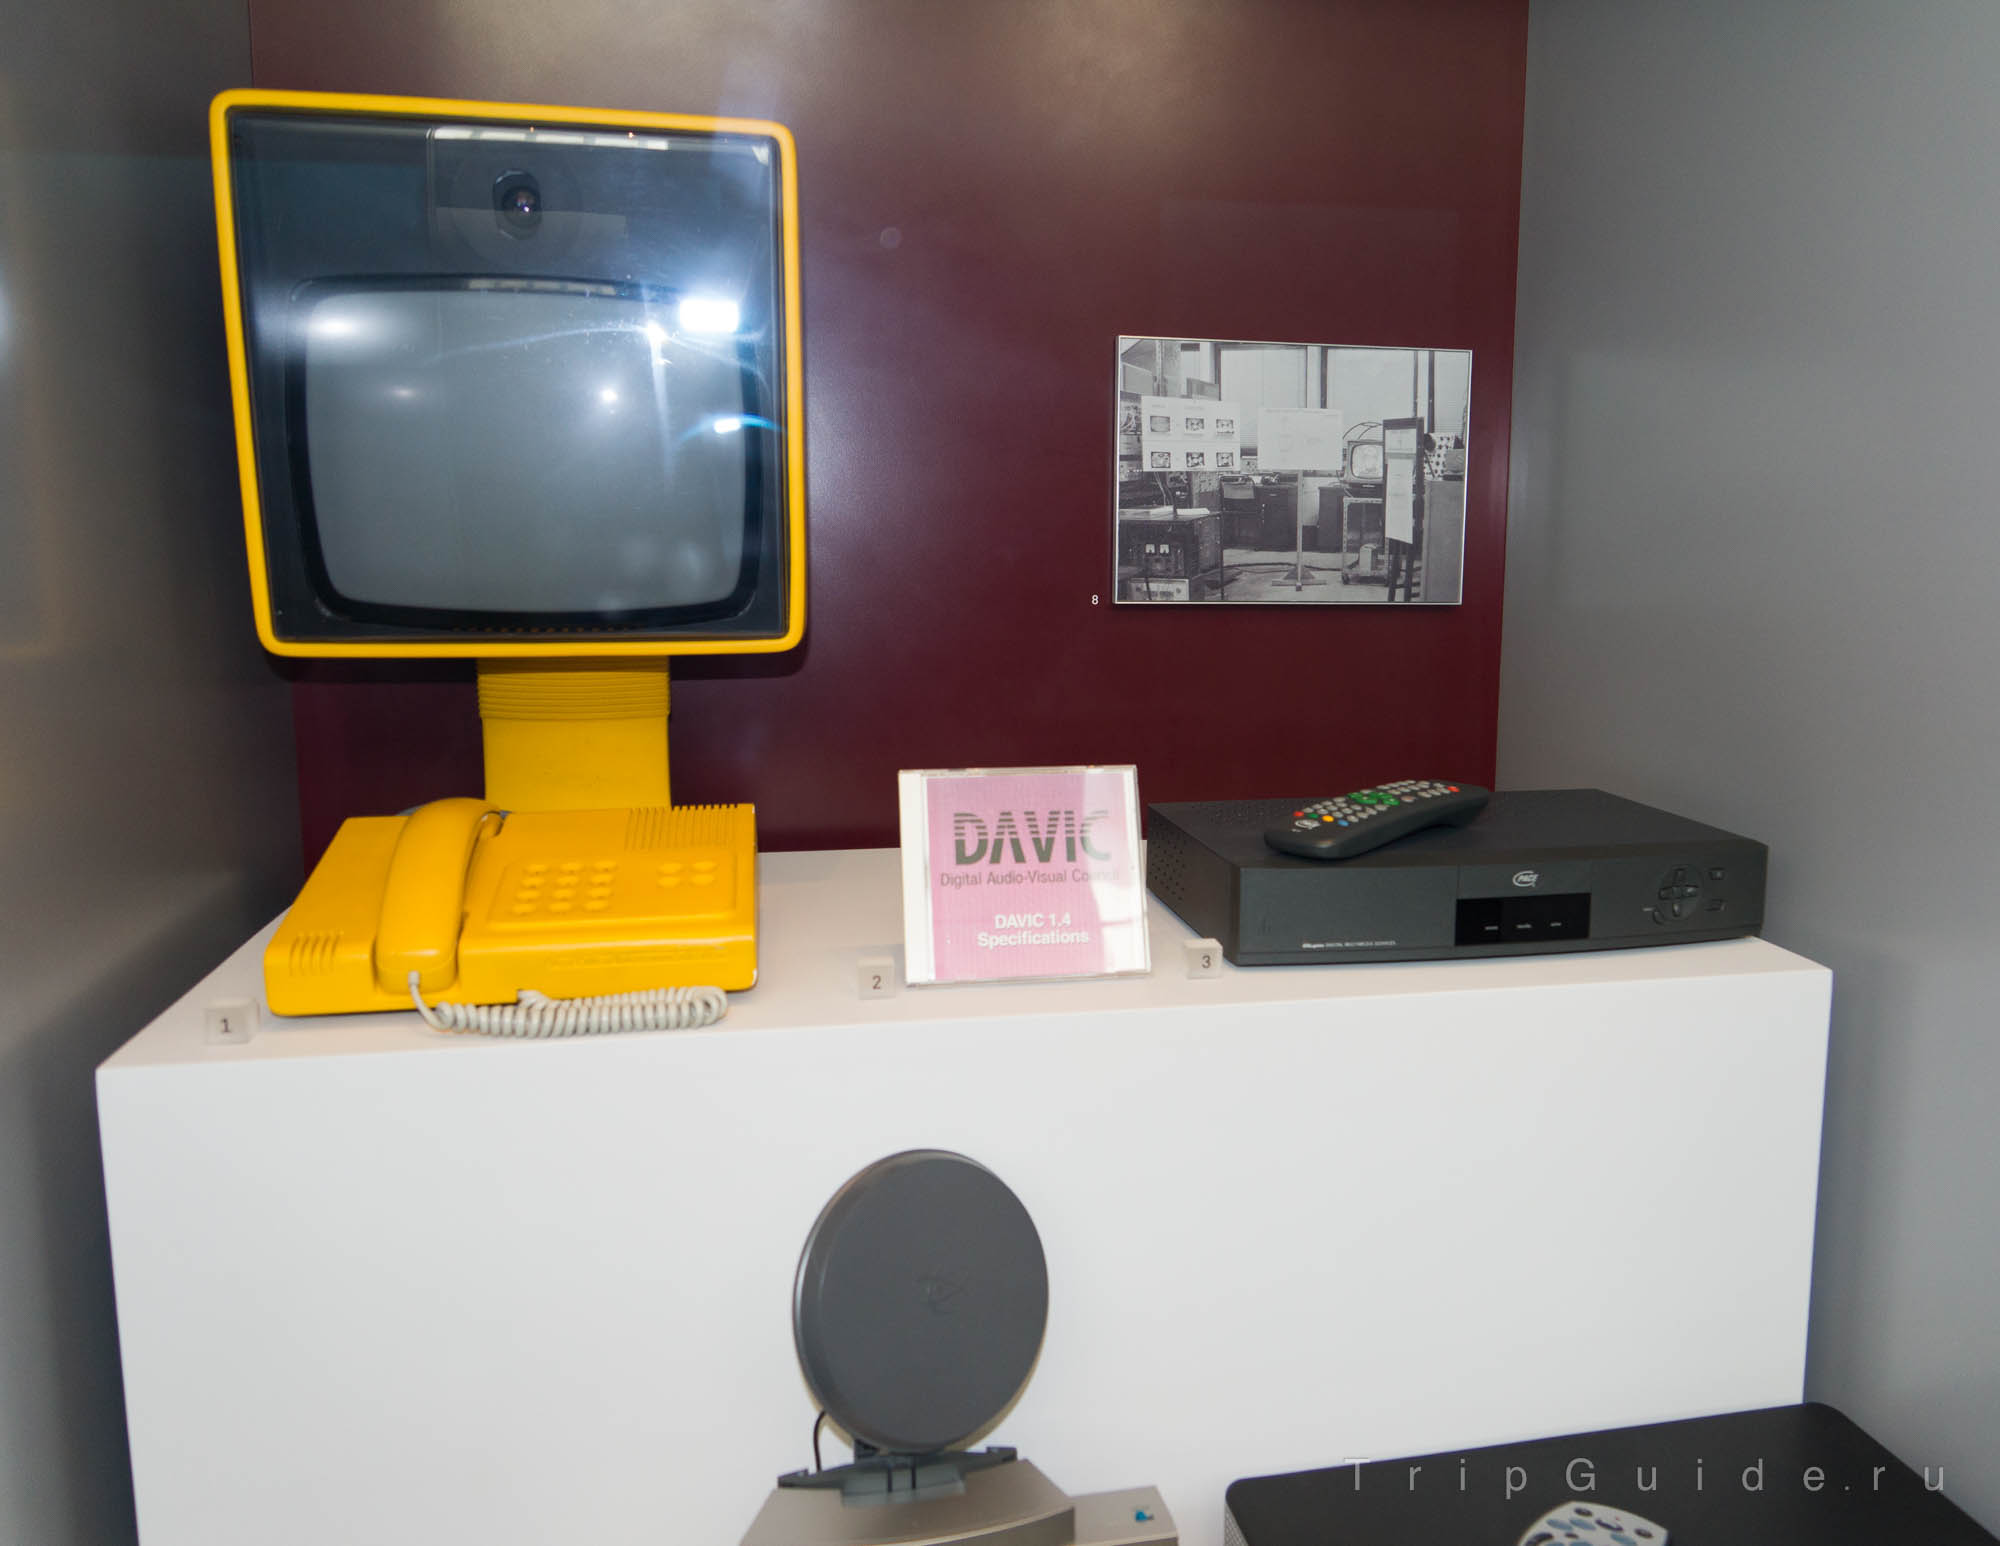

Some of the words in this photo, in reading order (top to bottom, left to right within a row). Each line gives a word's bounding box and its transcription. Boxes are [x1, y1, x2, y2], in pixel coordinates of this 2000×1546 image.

[1091, 594, 1099, 605] 8
[954, 810, 1110, 865] DAVIC
[940, 871, 982, 889] Digital
[986, 869, 1067, 886] Audio-Visual
[994, 914, 1044, 929] DAVIC
[1048, 913, 1071, 927] 1.4
[976, 930, 1089, 948] Specifications
[1201, 955, 1211, 969] 3
[872, 976, 881, 991] 2
[220, 1018, 231, 1033] 1
